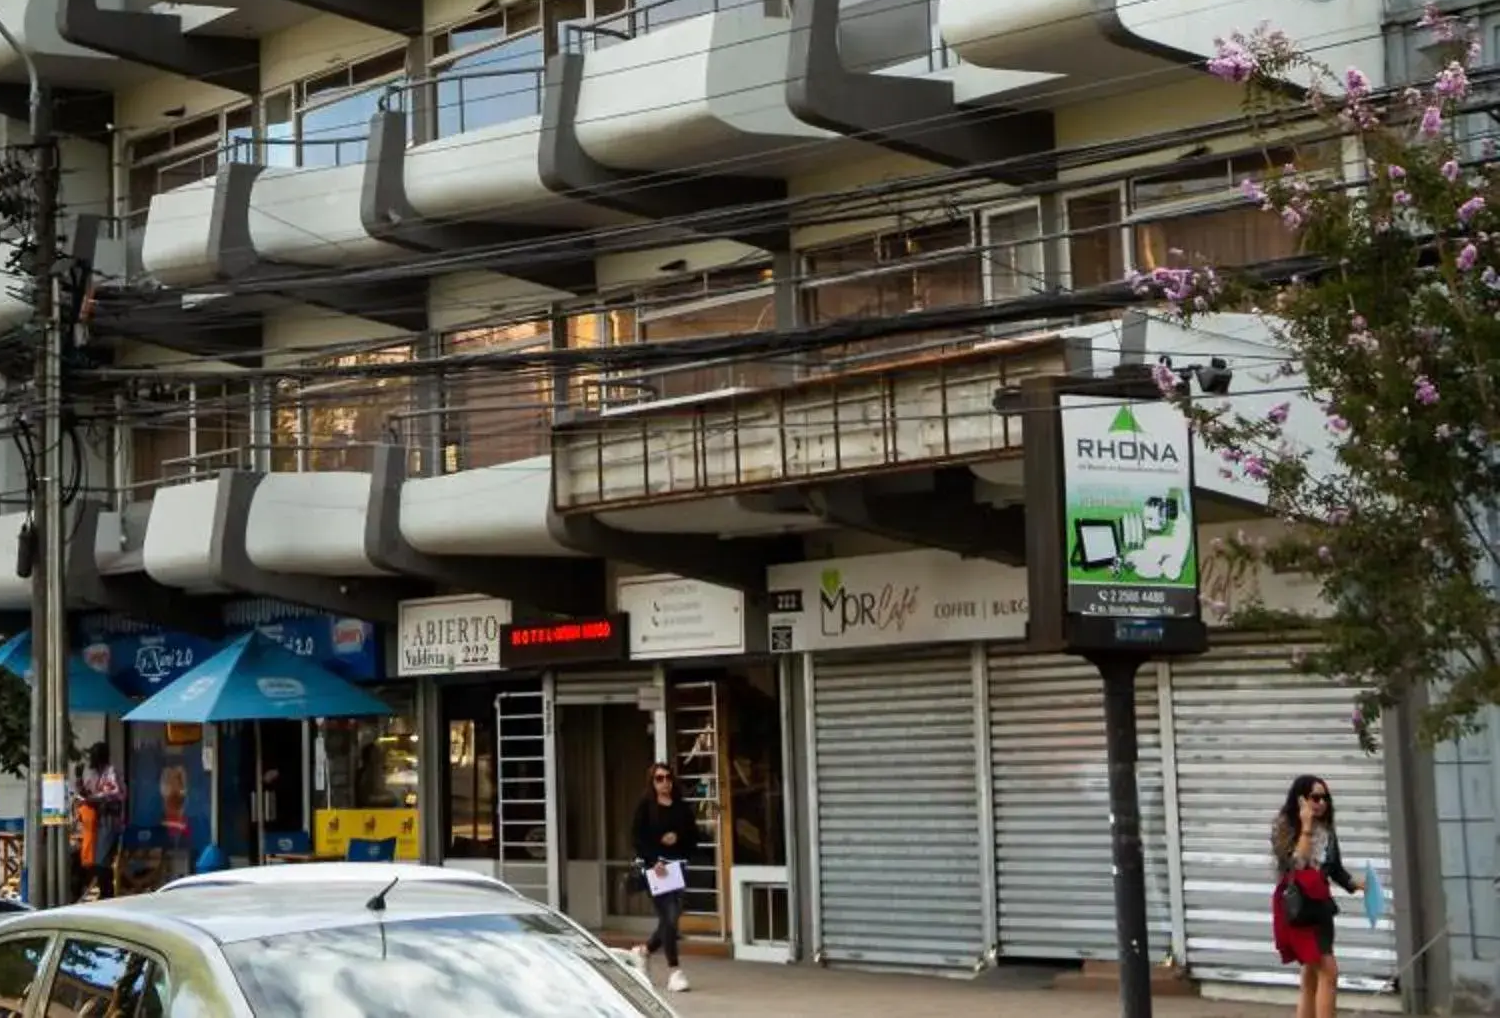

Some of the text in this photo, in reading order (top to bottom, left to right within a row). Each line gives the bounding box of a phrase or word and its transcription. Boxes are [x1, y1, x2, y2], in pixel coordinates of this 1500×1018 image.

[1076, 438, 1179, 463] RHONA
[934, 601, 977, 620] COFFEE
[412, 614, 498, 647] ABIERTO
[405, 643, 489, 667] Valdivia 222
